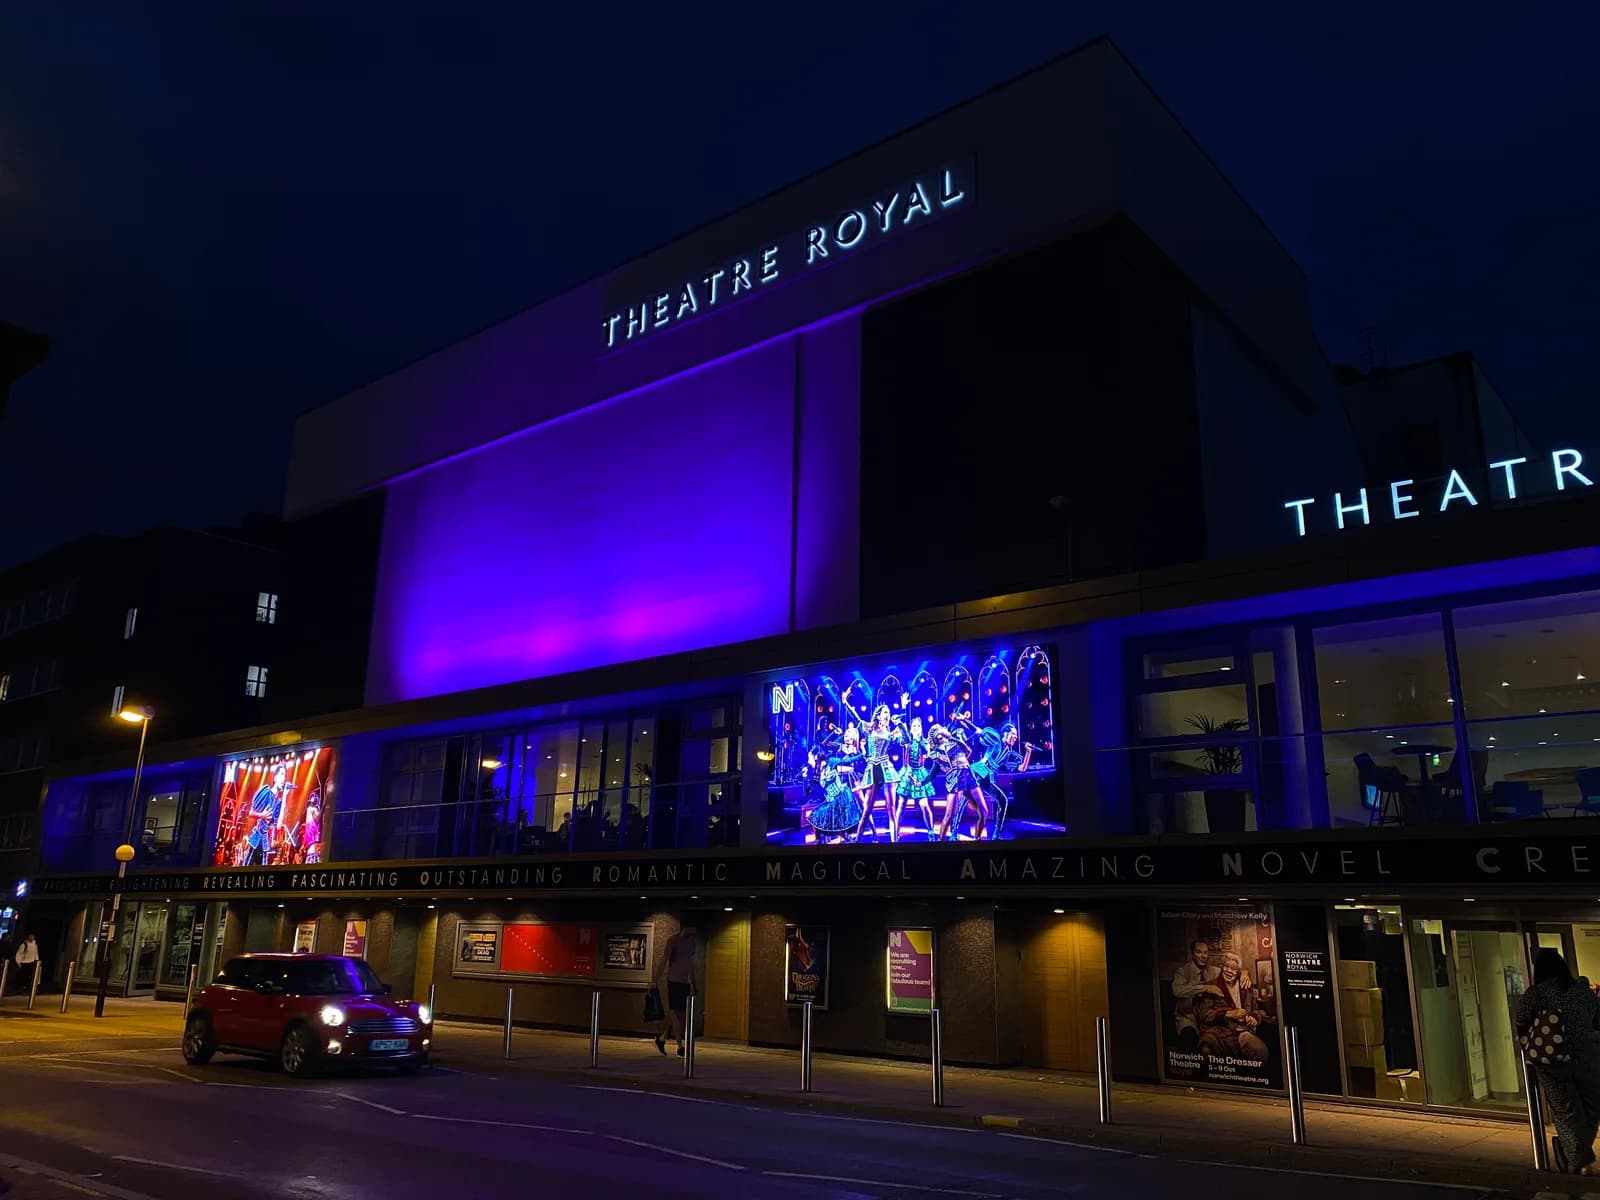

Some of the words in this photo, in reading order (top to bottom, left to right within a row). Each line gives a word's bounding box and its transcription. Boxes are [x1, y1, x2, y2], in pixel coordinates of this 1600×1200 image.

[601, 245, 780, 348] THEATRE
[805, 169, 965, 264] ROYAL
[1284, 448, 1595, 537] THEATR
[772, 684, 794, 714] N
[203, 874, 276, 889] REVEALING
[291, 871, 399, 888] FASCINATING
[419, 867, 563, 887] OUTSTANDING
[592, 863, 728, 884] ROMANTIC
[766, 860, 912, 881] MAGICAL
[959, 855, 1155, 880] AMAZING
[1222, 848, 1391, 877] NOVEL
[1476, 845, 1588, 873] CRE
[1249, 911, 1268, 921] Kelly
[889, 932, 902, 948] N
[1169, 1051, 1204, 1062] Norwich
[1169, 1059, 1201, 1069] Theatre
[1208, 1055, 1225, 1064] The
[1226, 1056, 1263, 1068] Dresser
